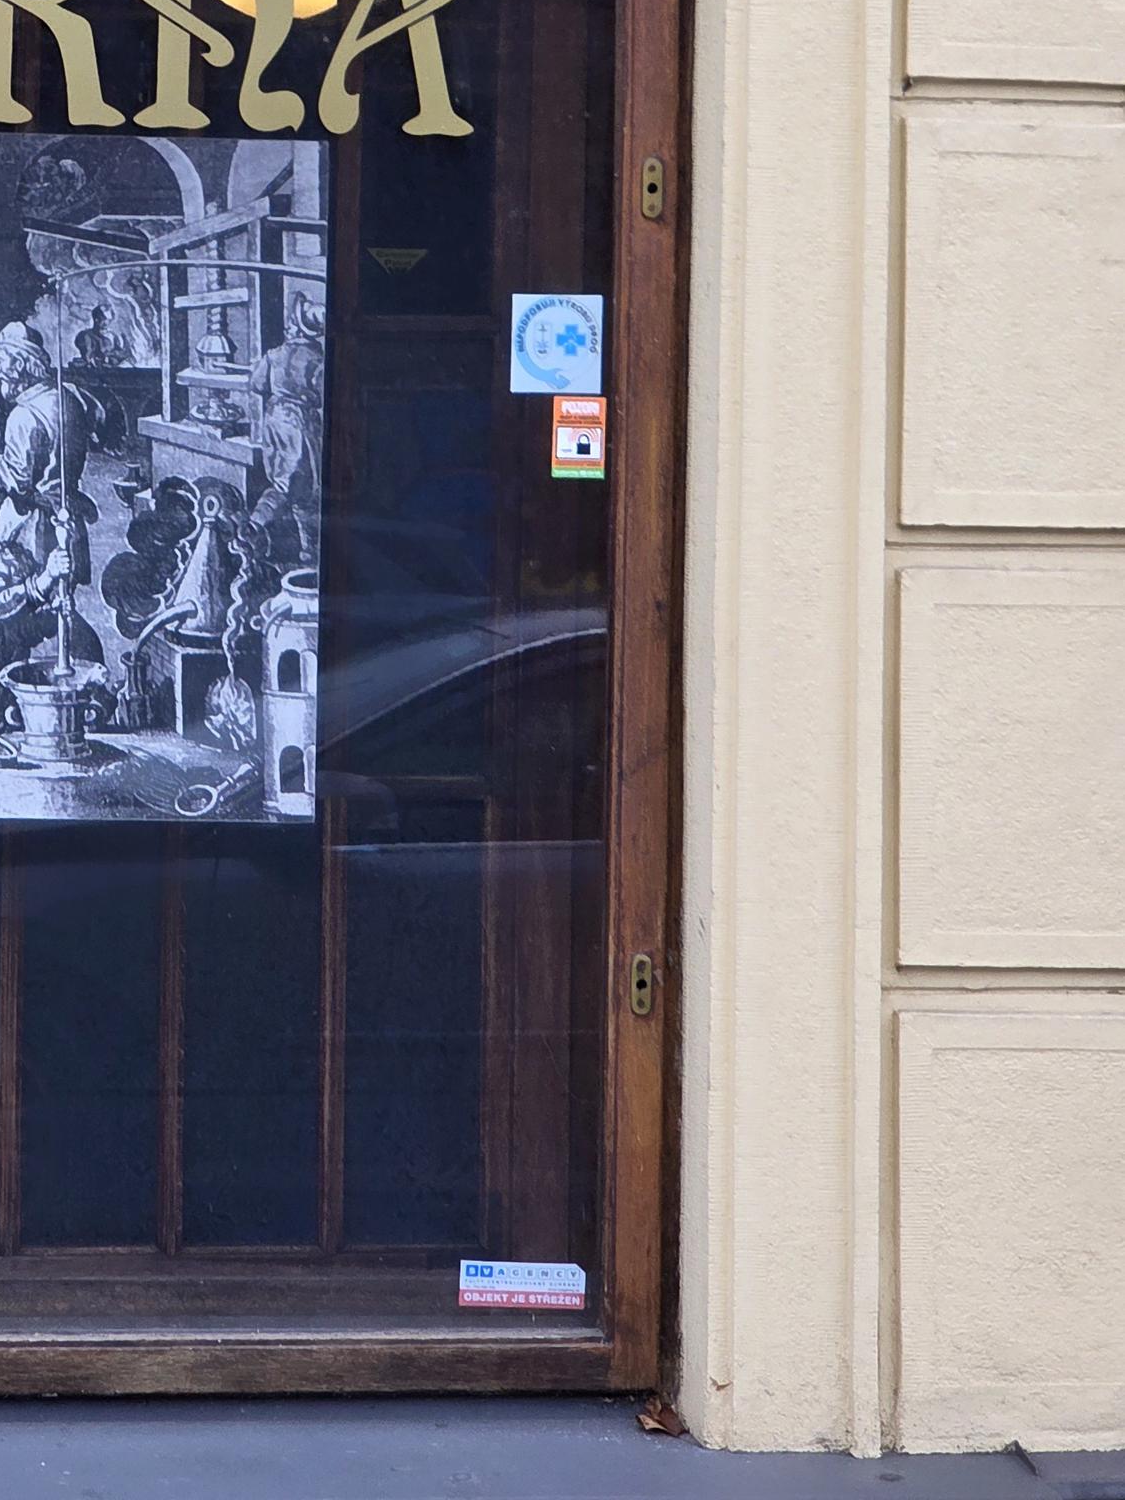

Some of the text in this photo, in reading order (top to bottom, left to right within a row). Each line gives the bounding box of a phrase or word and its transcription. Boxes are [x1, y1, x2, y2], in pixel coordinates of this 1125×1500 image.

[463, 1292, 581, 1306] OBJEKT JE STŘEŽEN
